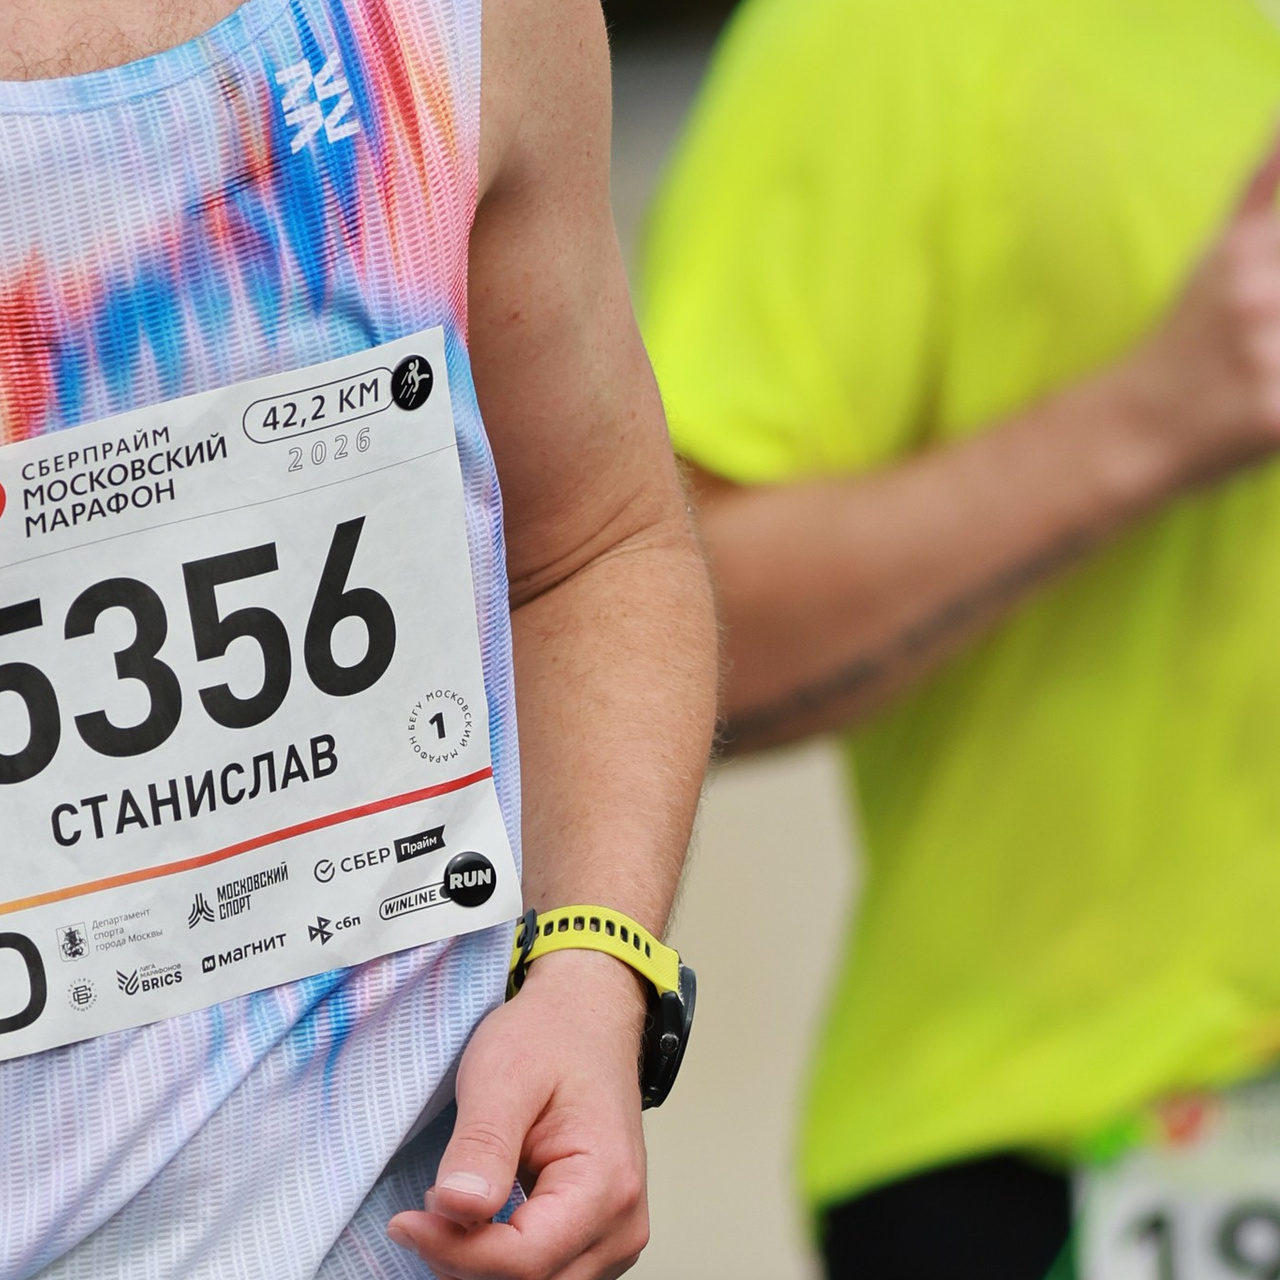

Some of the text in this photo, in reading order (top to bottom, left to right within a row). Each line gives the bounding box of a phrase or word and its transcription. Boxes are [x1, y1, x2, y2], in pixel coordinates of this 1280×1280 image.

[262, 377, 379, 431] 42,2 КМ
[21, 426, 170, 480] СБЕРПРАЙМ
[287, 427, 371, 473] 2026
[22, 432, 228, 510] МОСКОВСКИЙ
[24, 478, 176, 538] МАРАФОН
[407, 701, 422, 731] БЕГУ
[428, 712, 446, 739] 1
[408, 735, 459, 764] МАРАФОН
[50, 733, 339, 847] СТАНИСЛАВ
[340, 835, 438, 873] СБЕР Прайм
[216, 861, 289, 903] МОСКОВСКИЙ
[449, 868, 492, 890] RUN
[218, 894, 252, 921] СПОРТ
[384, 889, 437, 916] WINLINE
[92, 908, 151, 930] Департамент
[335, 916, 361, 931] сбп
[93, 927, 124, 941] спорта
[95, 929, 163, 952] города Москвы
[218, 933, 287, 967] магнит
[141, 971, 183, 992] BRICS
